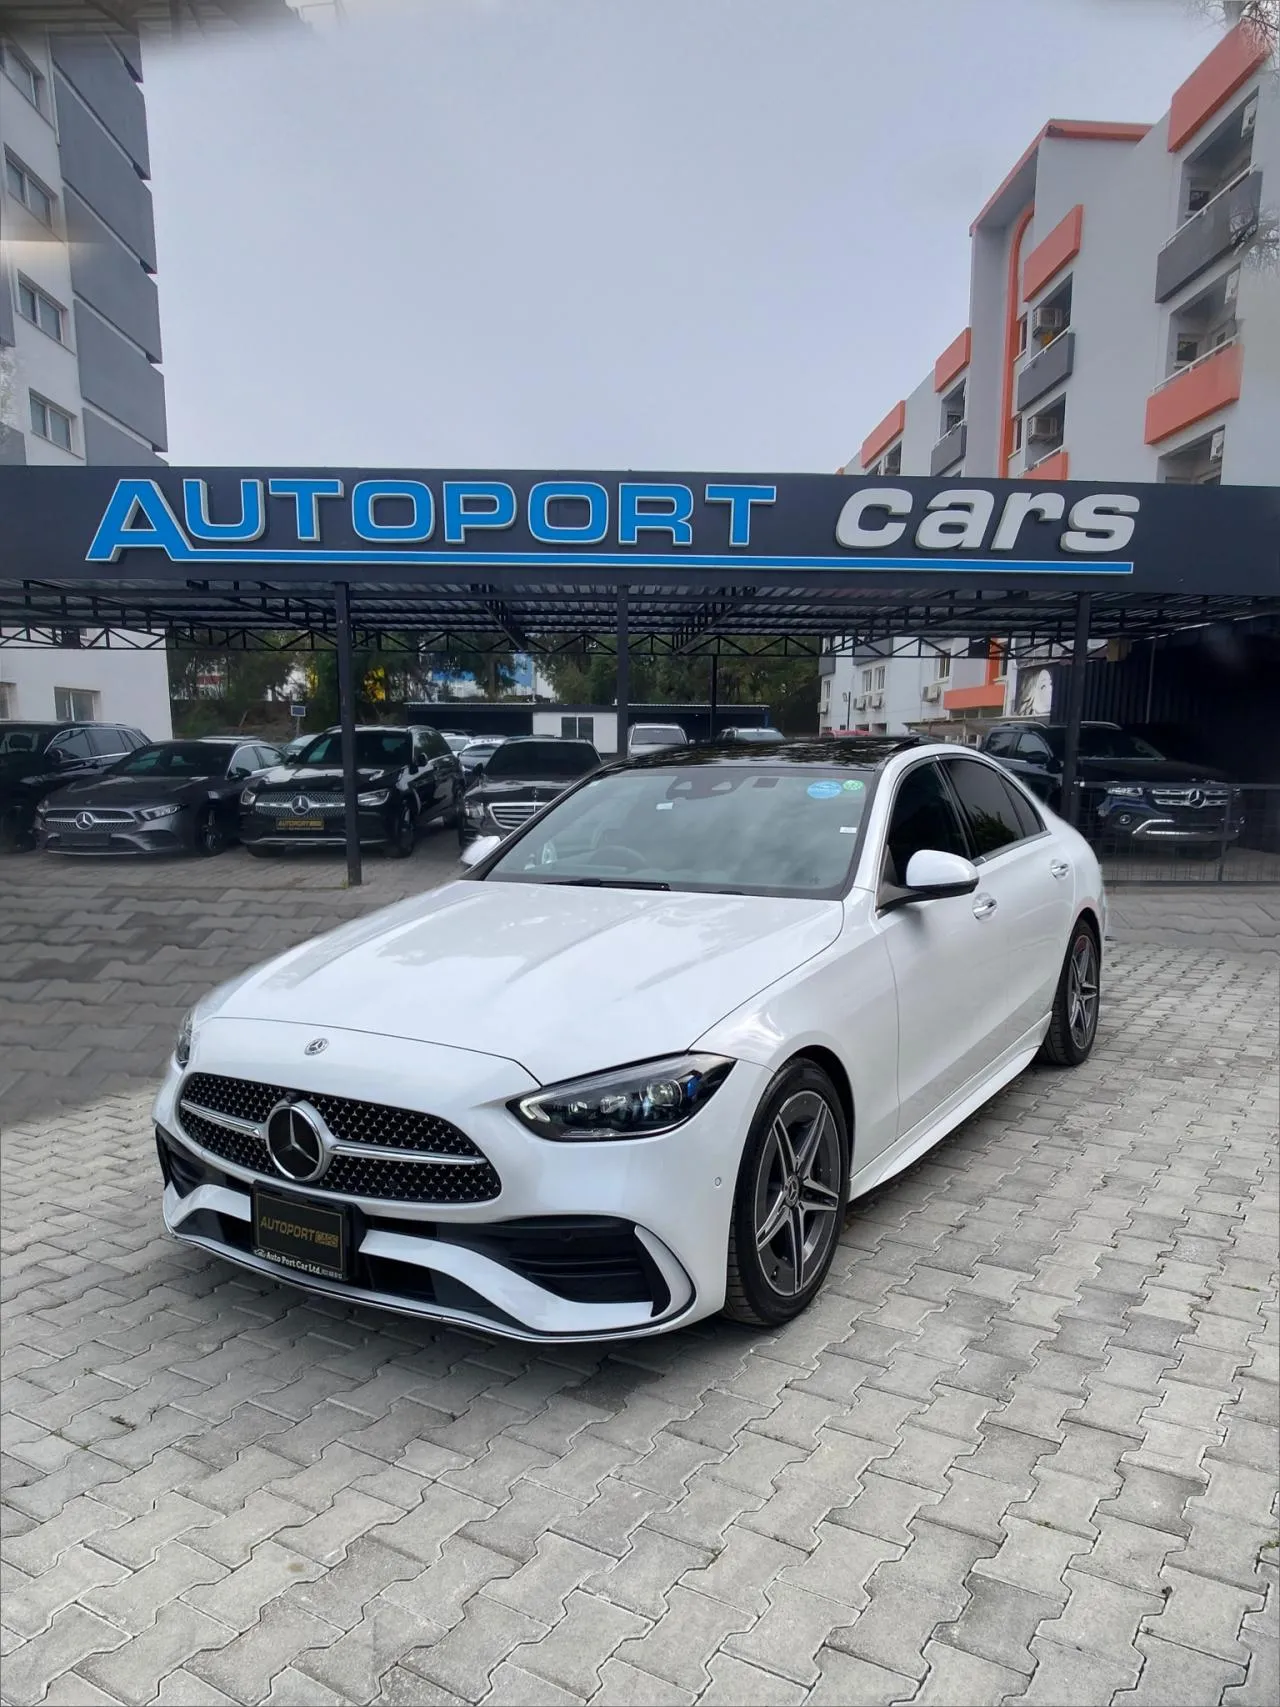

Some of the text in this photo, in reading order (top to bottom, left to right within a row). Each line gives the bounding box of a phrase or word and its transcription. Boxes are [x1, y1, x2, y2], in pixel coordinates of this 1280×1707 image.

[85, 478, 1141, 563] AUTOPORT cars
[260, 1216, 316, 1241] AUTOPORT
[266, 1251, 281, 1263] Auto
[281, 1256, 296, 1268] Port
[296, 1260, 308, 1271] Car
